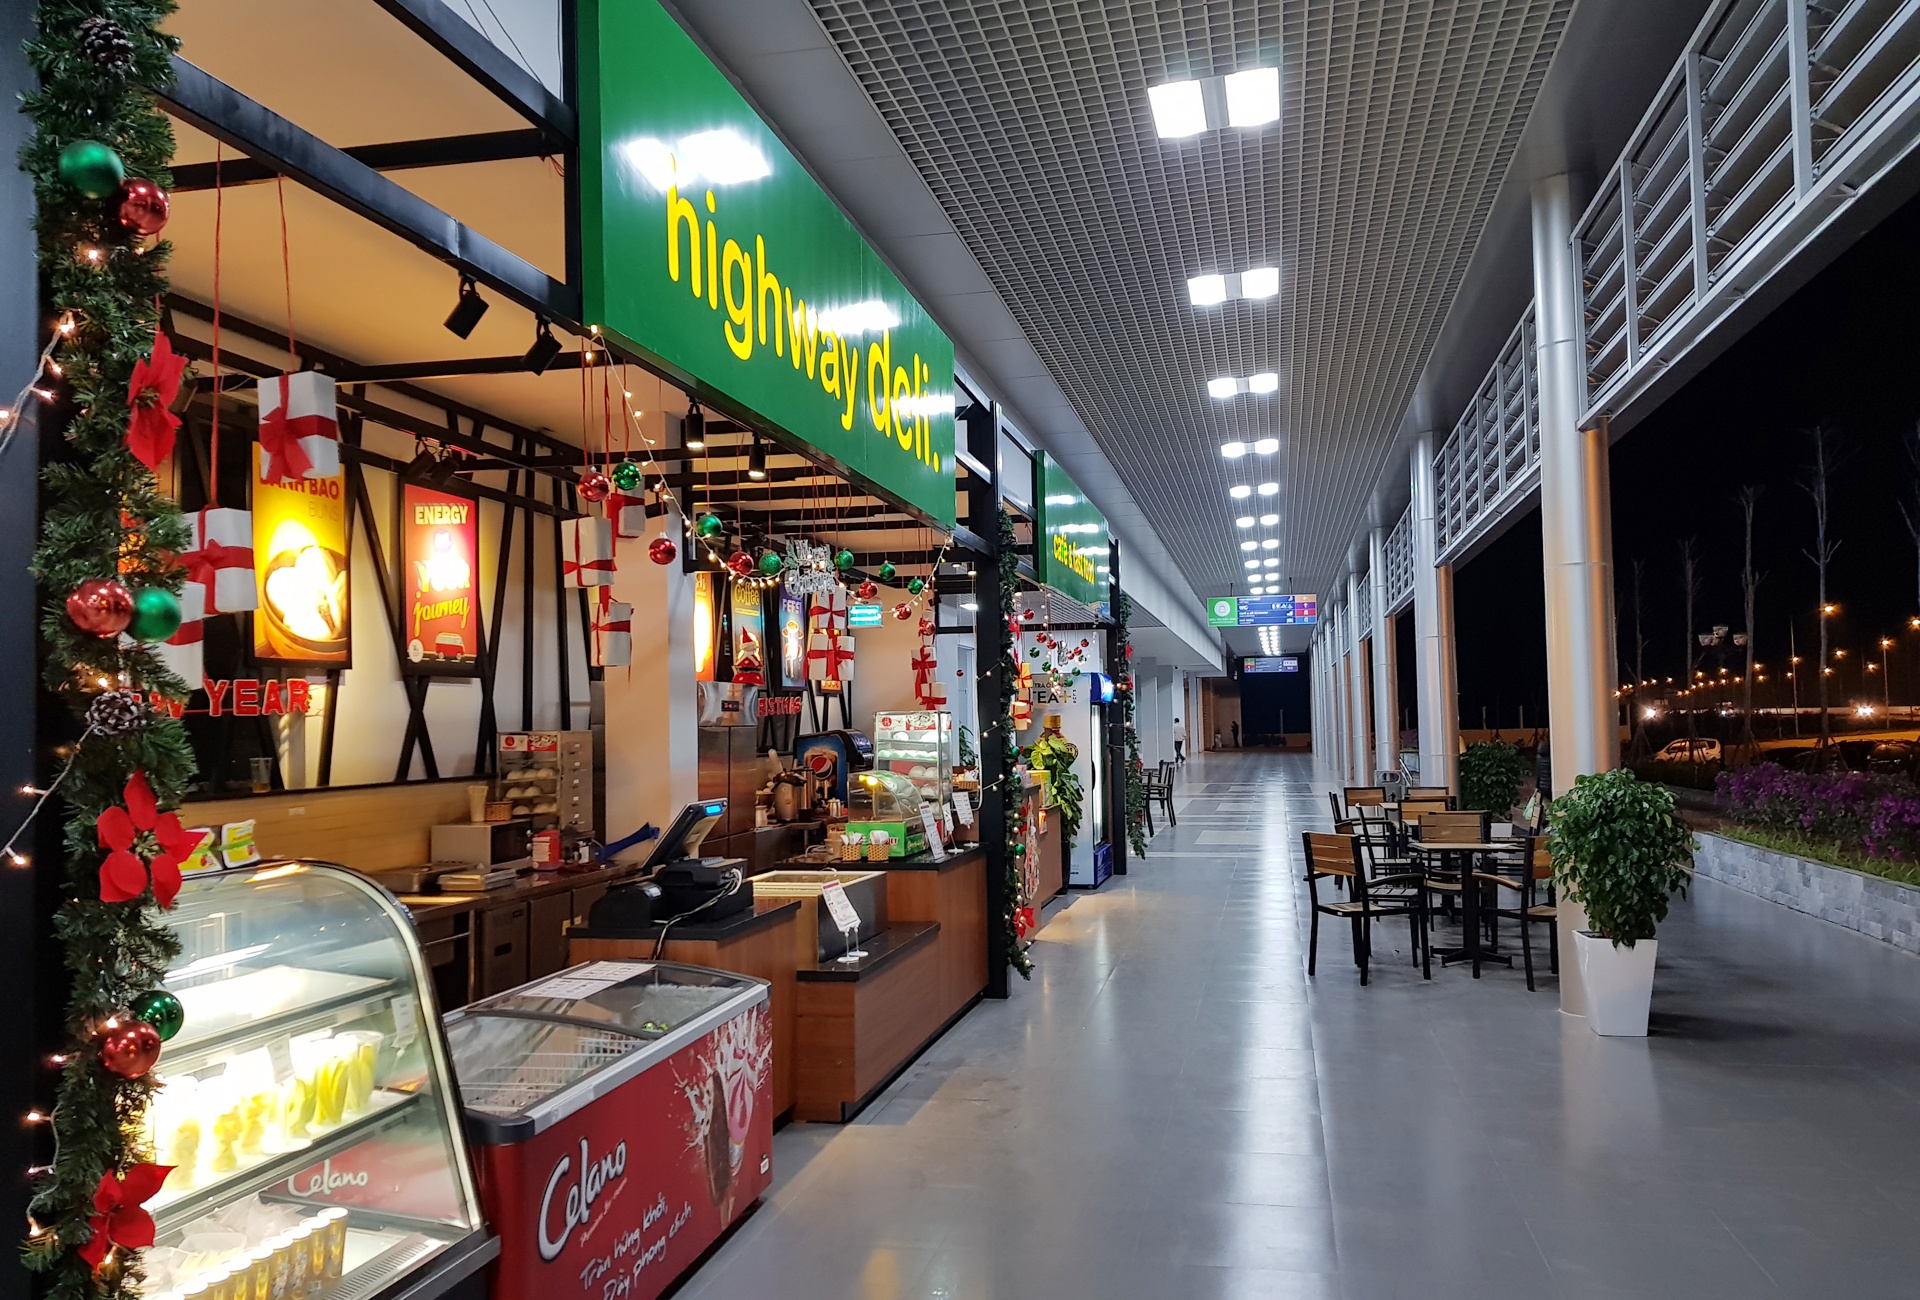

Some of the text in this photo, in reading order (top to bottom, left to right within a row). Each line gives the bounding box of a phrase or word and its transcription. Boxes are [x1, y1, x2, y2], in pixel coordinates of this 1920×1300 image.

[666, 152, 940, 473] highway deli.
[415, 503, 470, 525] ENERGY
[413, 591, 471, 638] journey
[735, 582, 760, 606] Coffee
[203, 678, 310, 716] YEAR
[288, 1159, 369, 1197] Celano
[539, 1137, 627, 1261] Celano
[633, 1236, 666, 1289] phong
